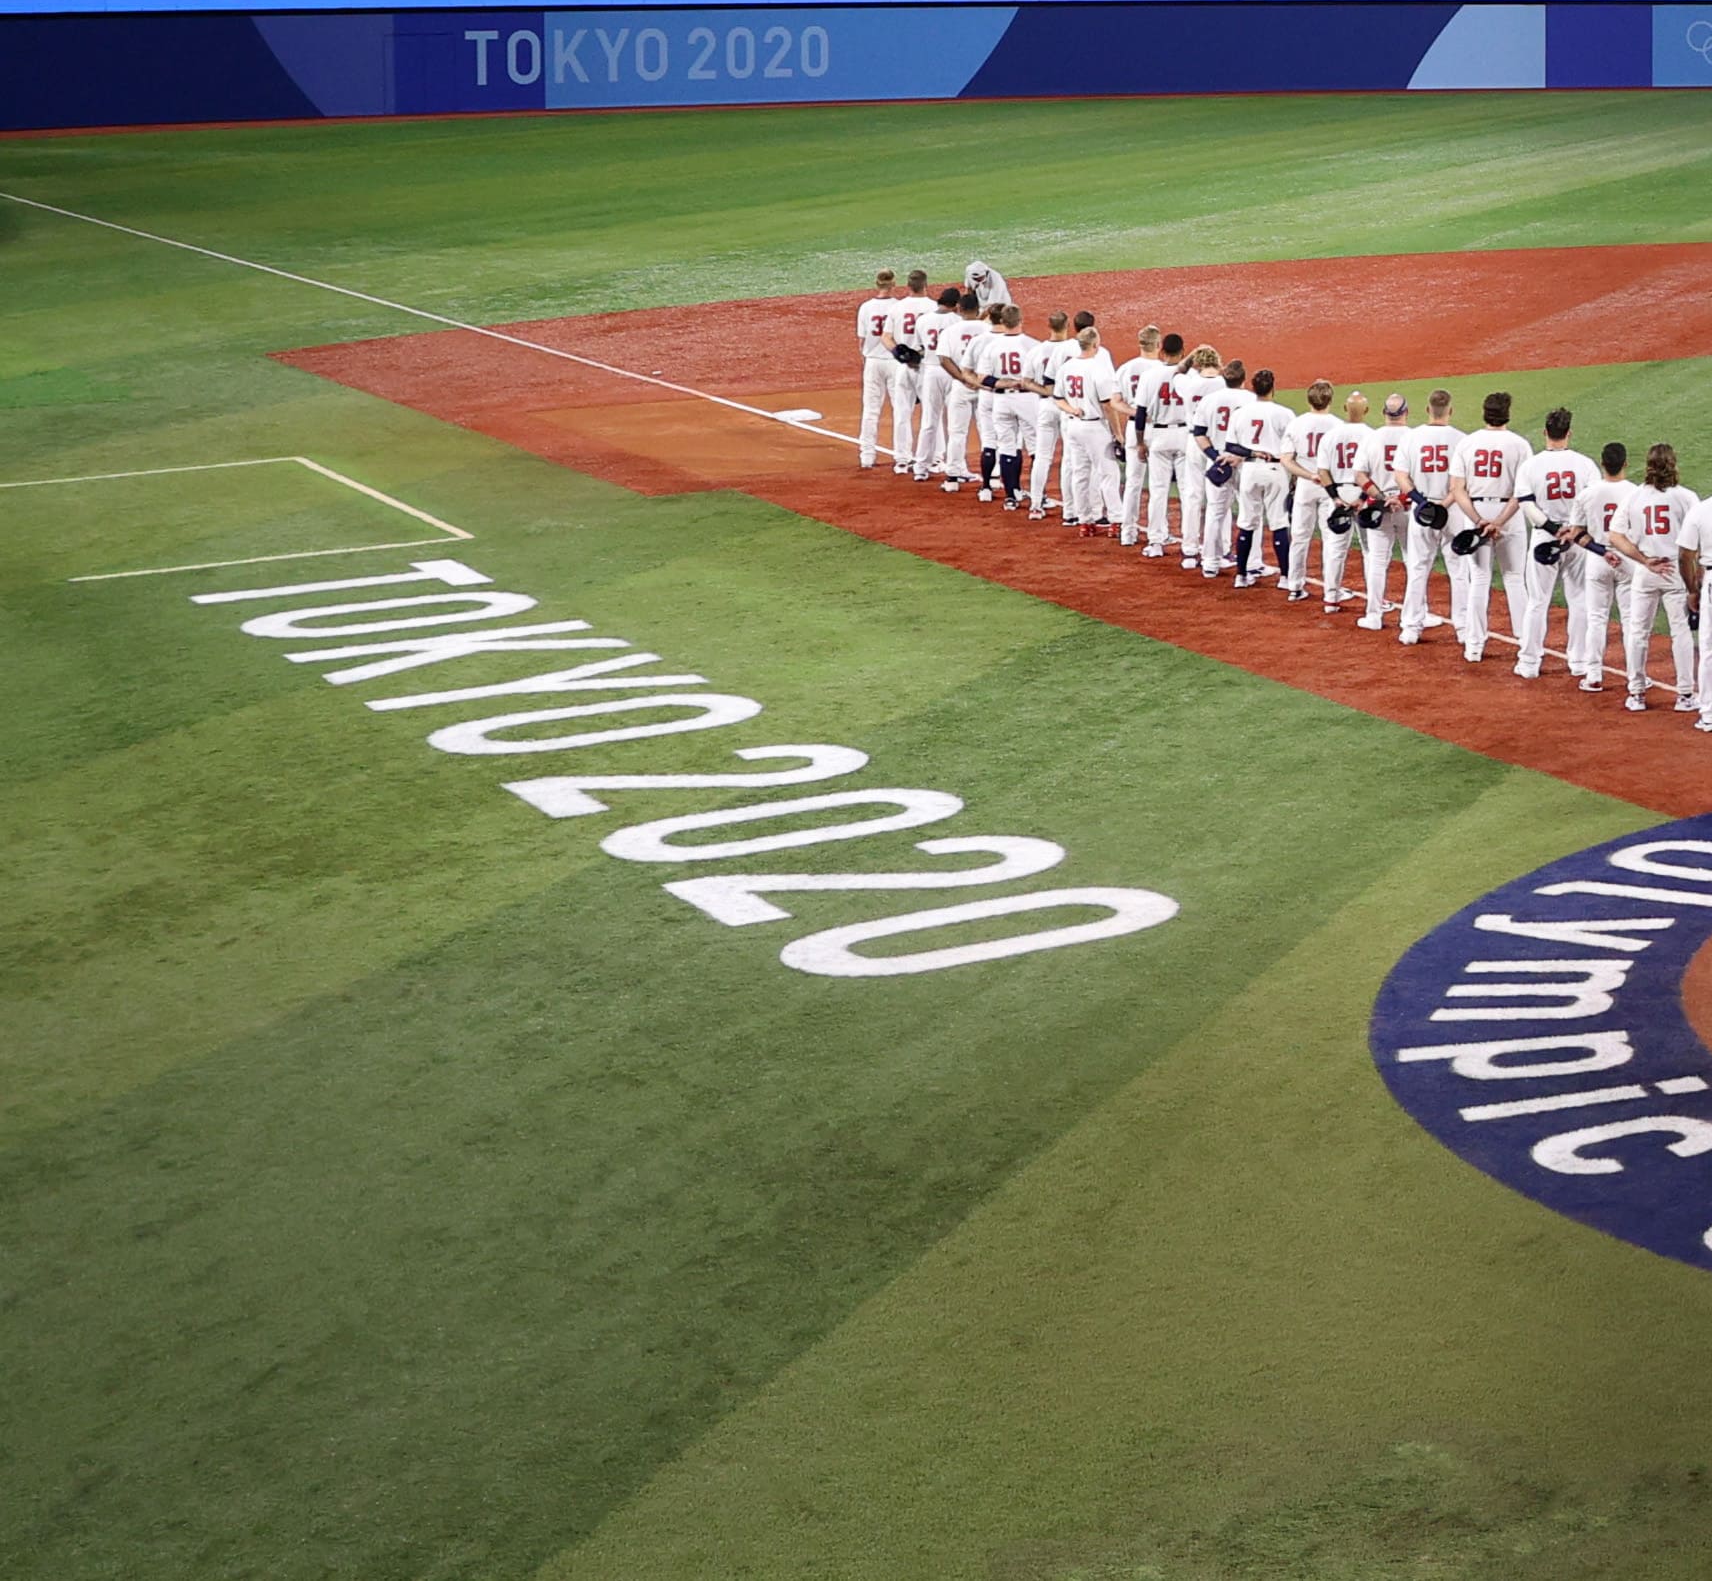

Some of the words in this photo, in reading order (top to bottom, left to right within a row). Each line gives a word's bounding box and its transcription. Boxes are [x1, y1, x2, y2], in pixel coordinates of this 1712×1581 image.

[465, 28, 669, 87] TOKYO
[687, 26, 830, 81] 2020
[871, 315, 888, 336] 3
[1000, 352, 1021, 375] 16
[1066, 375, 1084, 398] 39
[1251, 419, 1264, 444] 7
[1336, 442, 1358, 469] 12
[1420, 445, 1449, 472] 25
[1474, 449, 1503, 478] 26
[1546, 471, 1576, 500] 23
[1643, 505, 1671, 535] 15
[190, 558, 762, 755] TOKYO
[500, 744, 1181, 977] 2020
